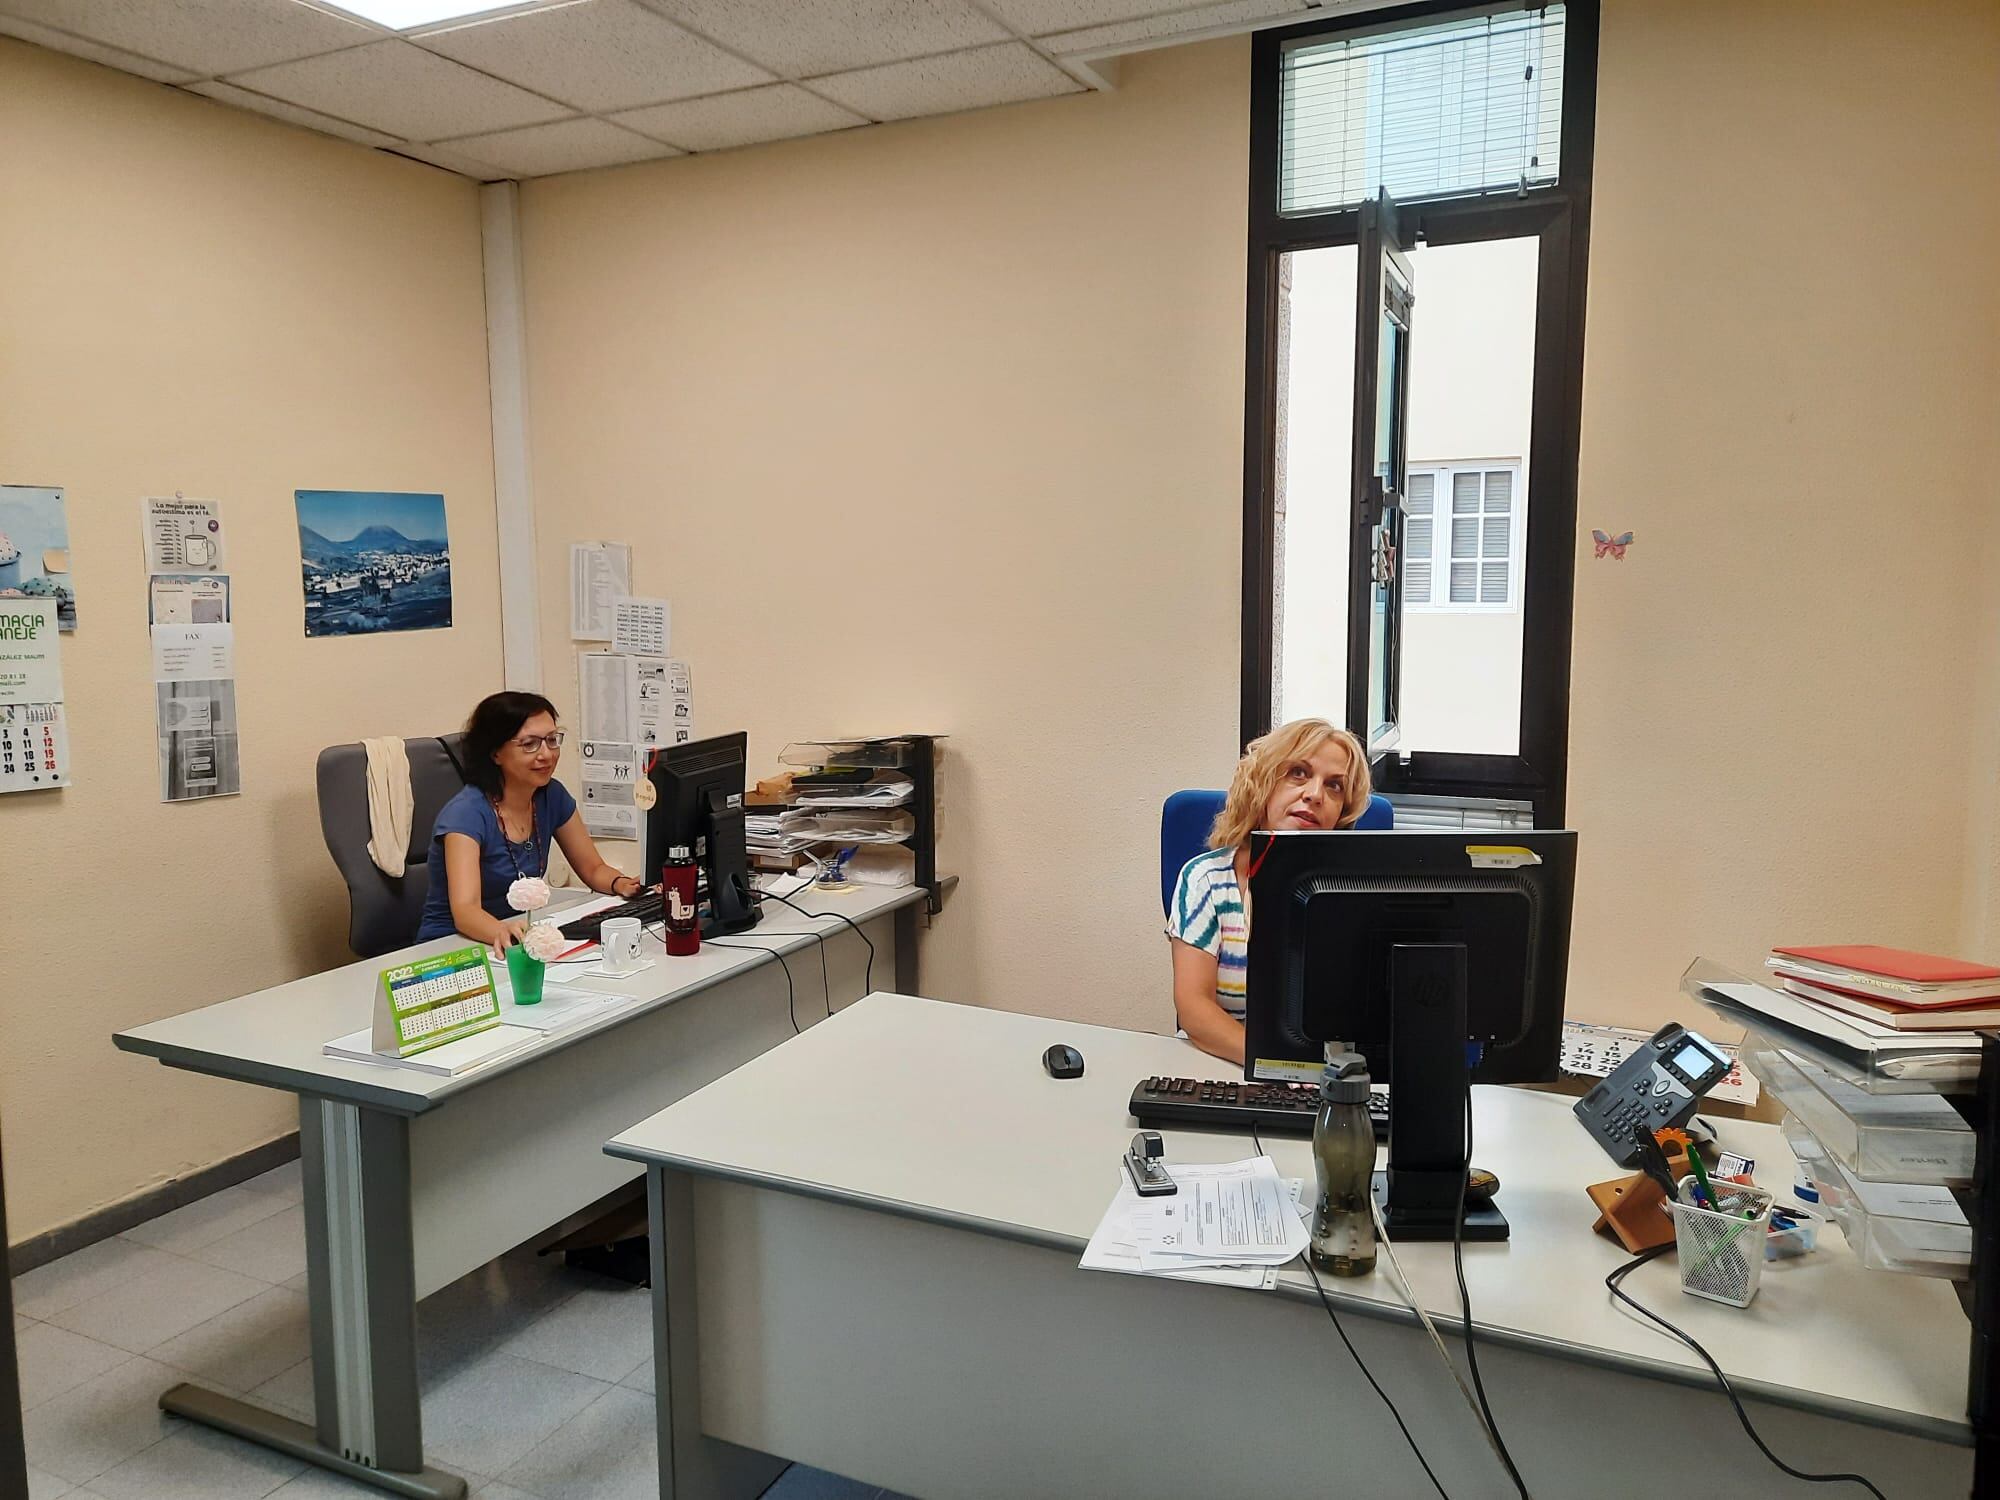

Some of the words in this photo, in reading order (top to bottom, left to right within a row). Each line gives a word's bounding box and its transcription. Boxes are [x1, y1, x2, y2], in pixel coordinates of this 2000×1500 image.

[3, 729, 9, 739] 3
[23, 728, 29, 737] 4
[43, 726, 50, 736] 5
[2, 741, 12, 750] 10
[23, 739, 32, 749] 11
[43, 737, 53, 747] 12
[3, 752, 13, 762] 17
[24, 750, 34, 760] 18
[44, 749, 54, 759] 19
[4, 764, 15, 774] 24
[24, 762, 35, 772] 25
[45, 760, 56, 770] 26
[386, 966, 413, 982] 2022
[1570, 1061, 1592, 1070] 28
[1600, 1057, 1621, 1065] 22
